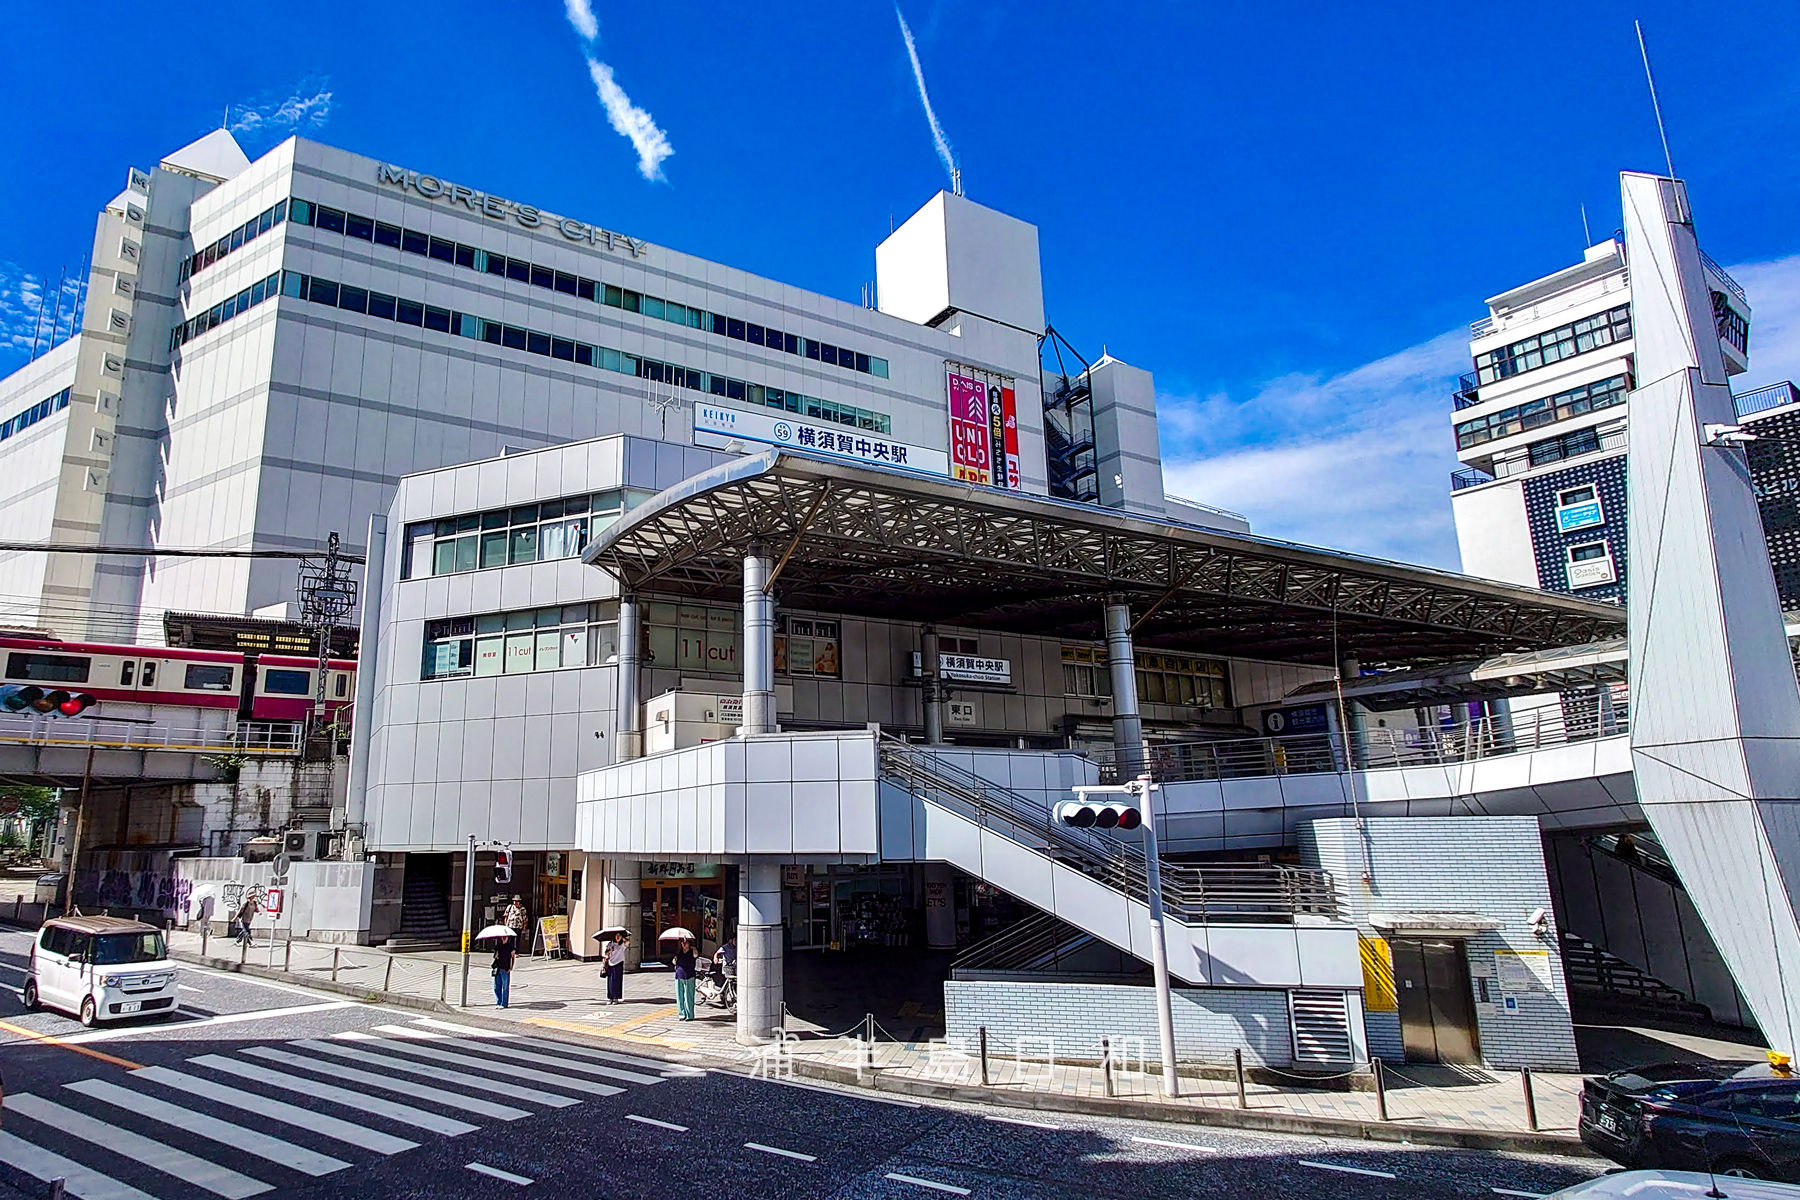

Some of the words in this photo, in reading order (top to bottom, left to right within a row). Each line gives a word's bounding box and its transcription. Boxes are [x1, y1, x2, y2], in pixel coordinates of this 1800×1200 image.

[378, 162, 541, 228] MORE'S
[559, 218, 648, 258] CITY
[952, 378, 982, 393] DAISO
[703, 408, 736, 423] KEIKYU
[777, 428, 789, 438] 59
[955, 424, 983, 446] UNI
[797, 426, 909, 464] 横須賀中央駅
[956, 443, 986, 464] QLO
[946, 656, 1004, 672] 横須賀中央駅
[951, 704, 973, 716] 東口
